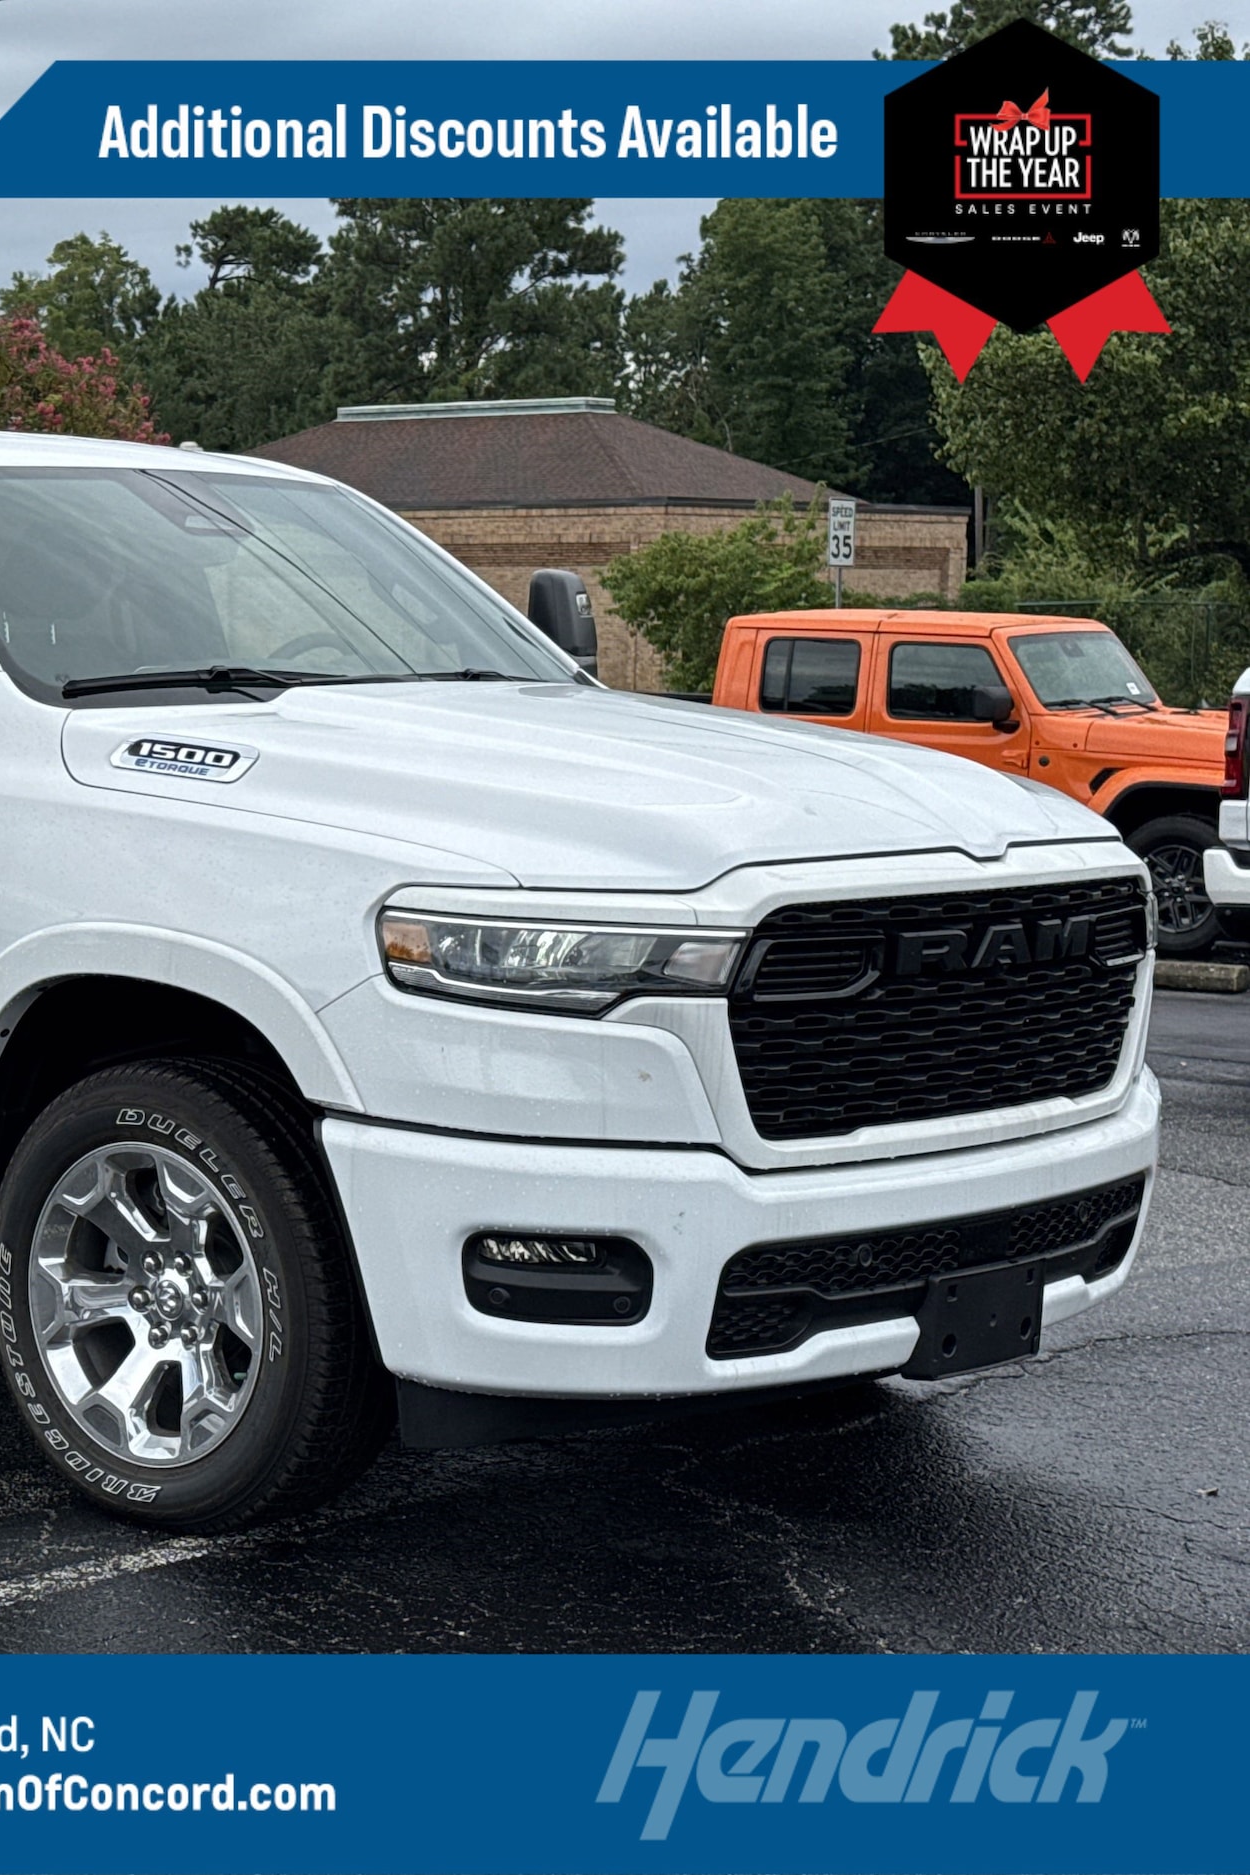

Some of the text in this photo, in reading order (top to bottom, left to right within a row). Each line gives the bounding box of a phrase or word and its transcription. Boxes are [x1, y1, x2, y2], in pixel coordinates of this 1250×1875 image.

[831, 506, 854, 518] SPEED
[833, 521, 851, 531] LIMIT
[831, 534, 852, 559] 35
[139, 742, 233, 767] 1500
[897, 915, 1090, 976] RAM
[116, 1107, 285, 1364] DUELER H/L
[0, 1241, 162, 1504] BRIDGESTONE
